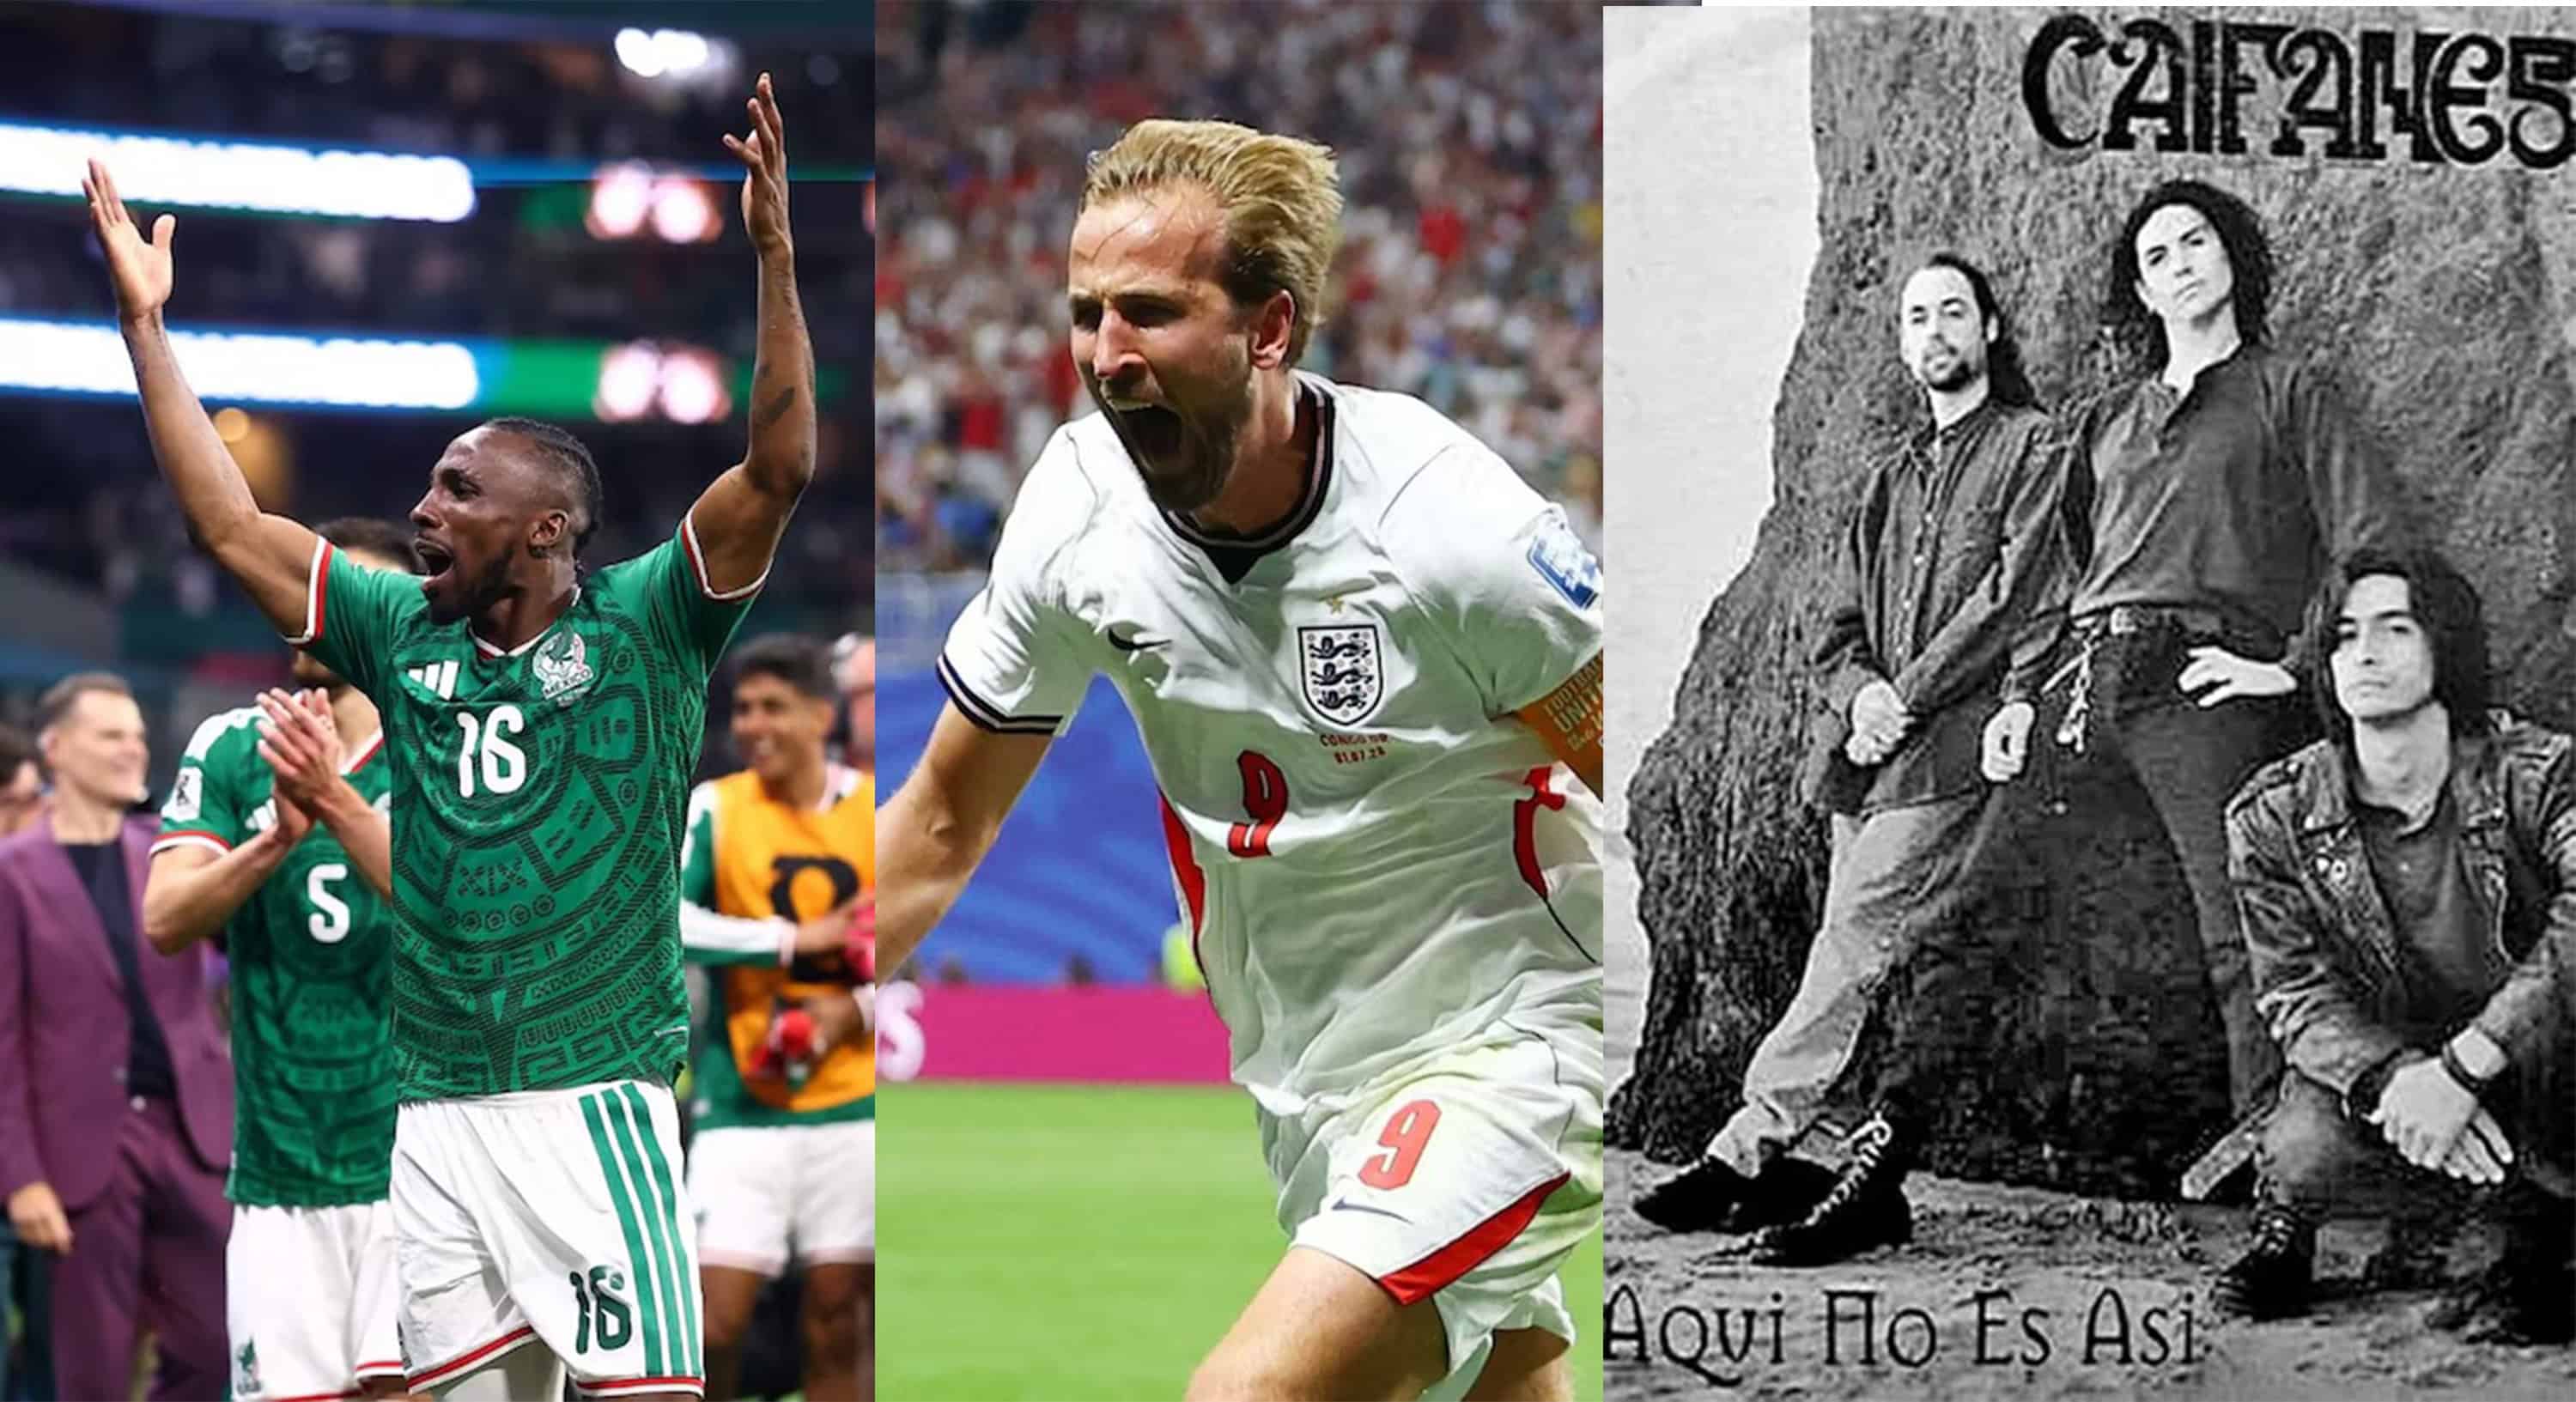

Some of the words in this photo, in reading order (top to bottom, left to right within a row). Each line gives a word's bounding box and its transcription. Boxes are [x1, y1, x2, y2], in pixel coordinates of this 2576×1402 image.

[455, 705, 527, 798] 16
[1227, 749, 1290, 859] 9
[307, 863, 351, 944] 5
[1356, 1098, 1443, 1192] 9
[568, 1264, 633, 1356] 16
[1972, 1288, 2051, 1367] Es
[2081, 1287, 2194, 1368] Asi
